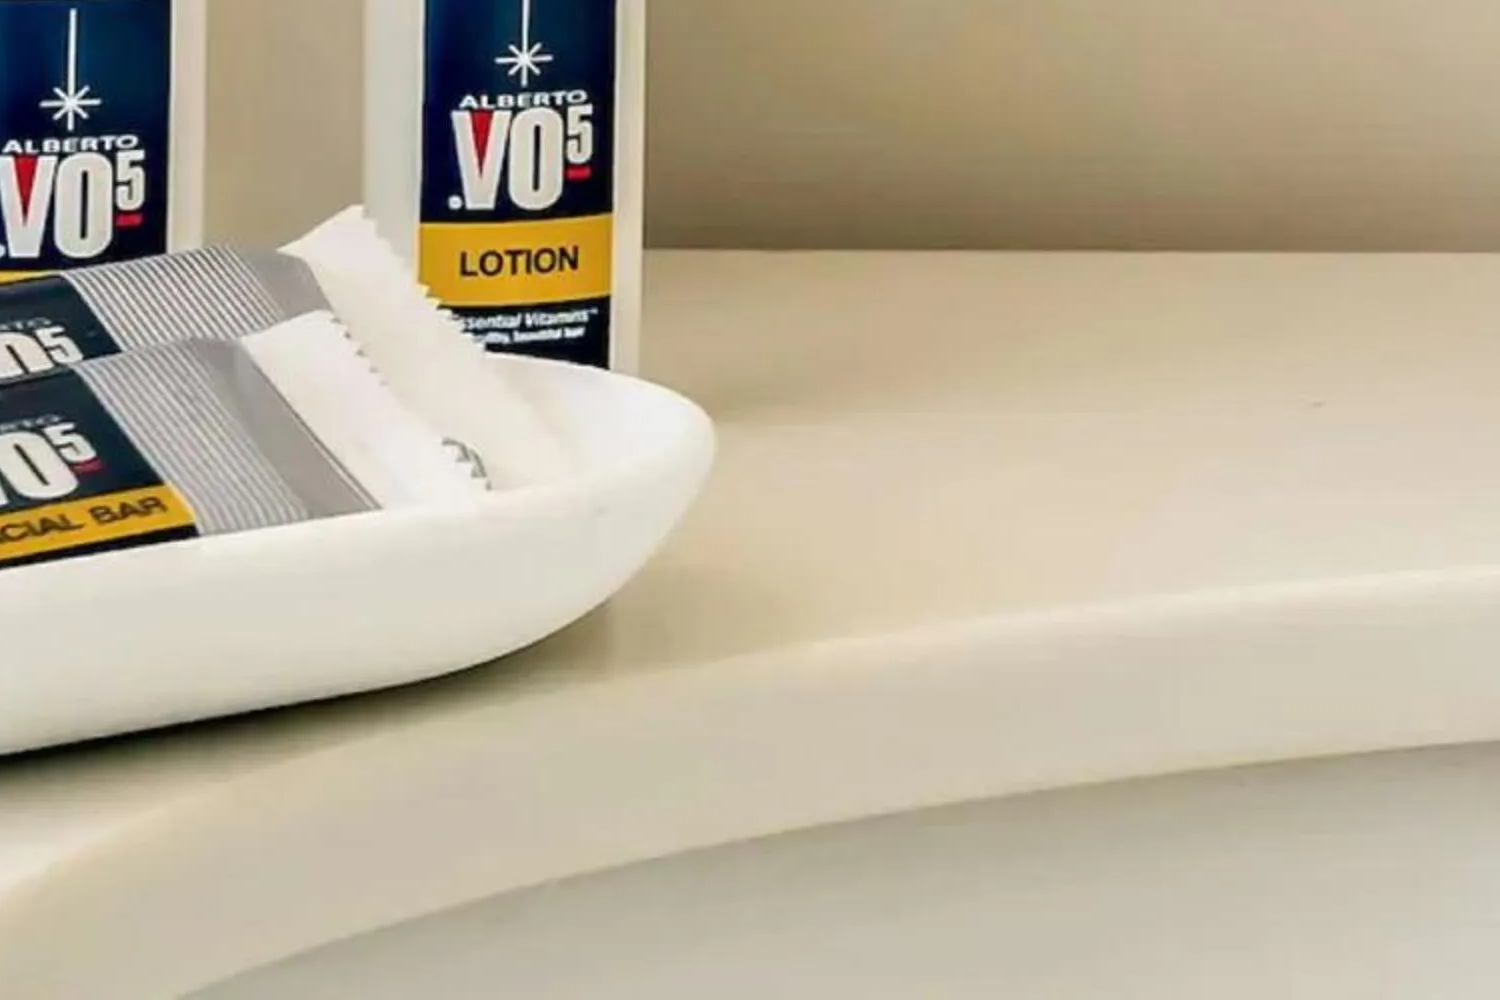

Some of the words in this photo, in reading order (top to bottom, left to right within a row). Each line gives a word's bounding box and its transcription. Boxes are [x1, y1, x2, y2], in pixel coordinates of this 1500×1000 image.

[458, 89, 588, 109] ALBERTO
[2, 134, 138, 154] ALBERTO
[459, 245, 580, 277] LOTION
[88, 496, 168, 523] BAR
